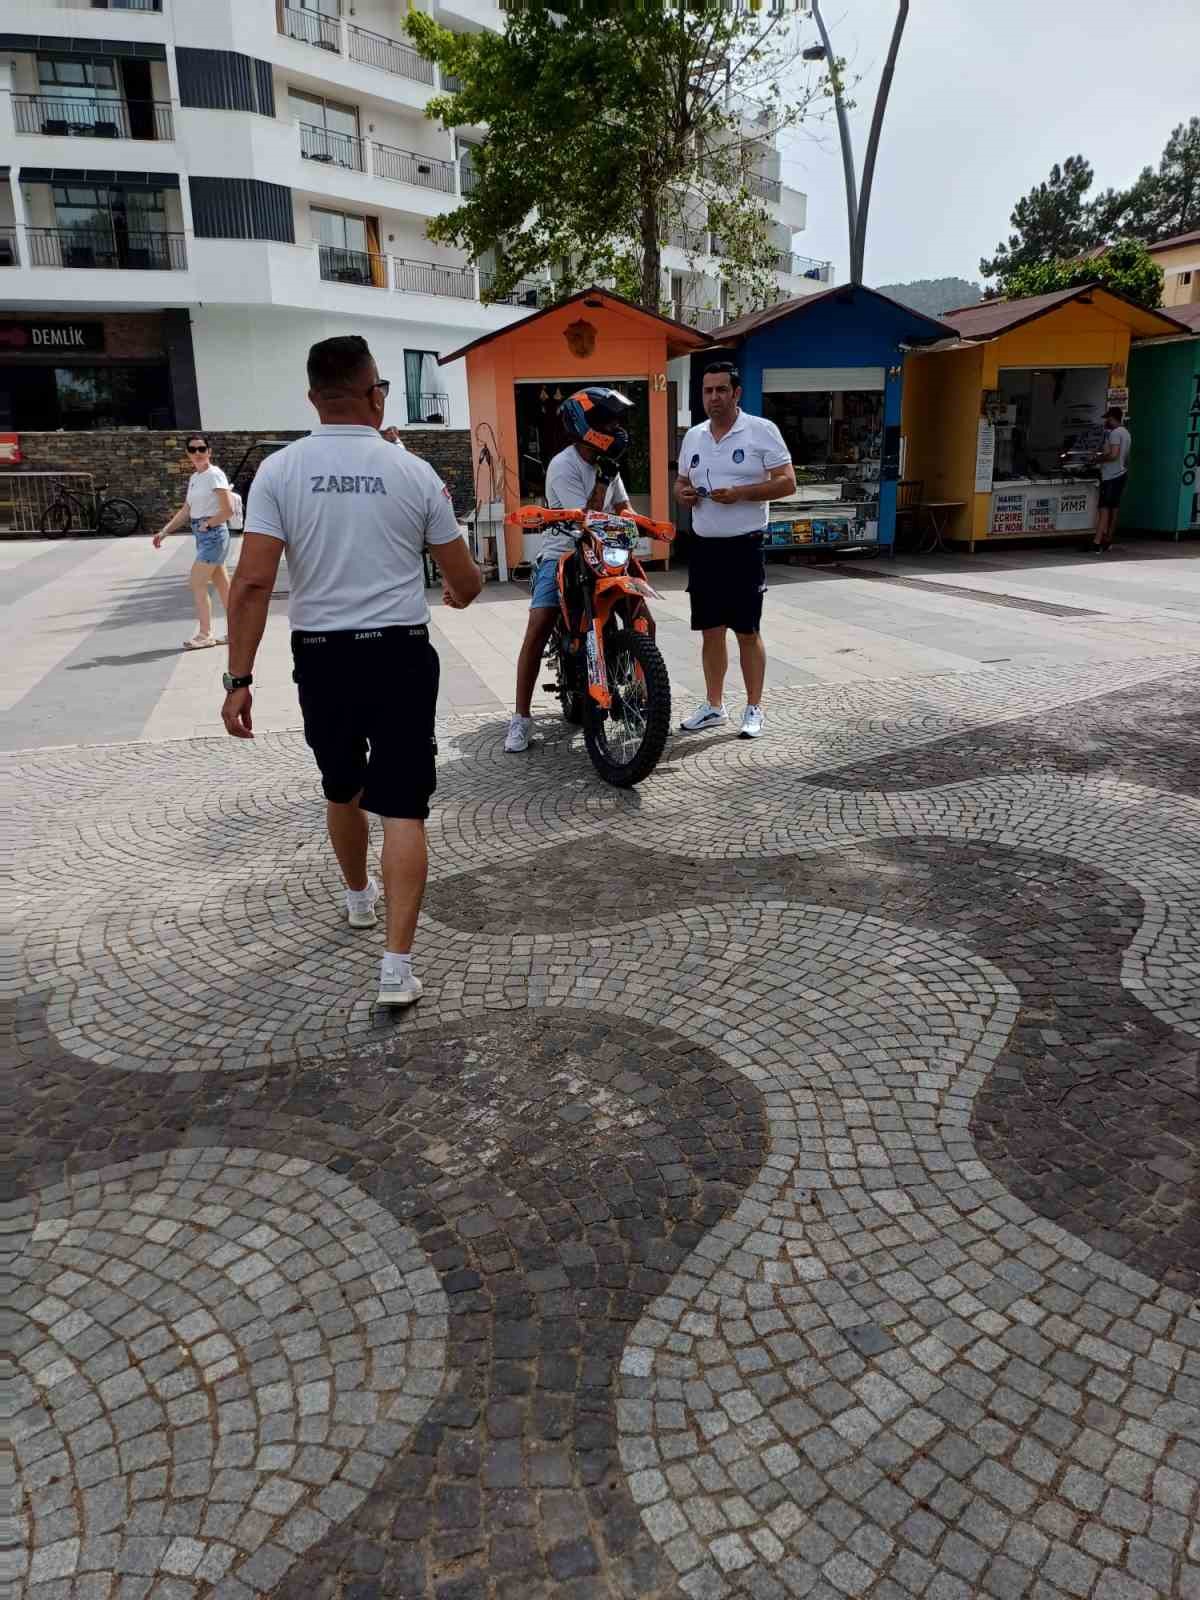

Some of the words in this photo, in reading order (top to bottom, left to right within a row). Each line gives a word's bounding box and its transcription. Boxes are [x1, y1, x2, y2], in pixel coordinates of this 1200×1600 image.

[31, 326, 85, 345] DEMLİK
[654, 373, 667, 391] 12
[311, 475, 387, 495] ZABITA
[1061, 500, 1087, 512] ИМЯ
[994, 512, 1023, 522] ECRIRE
[354, 632, 383, 640] ZABITA
